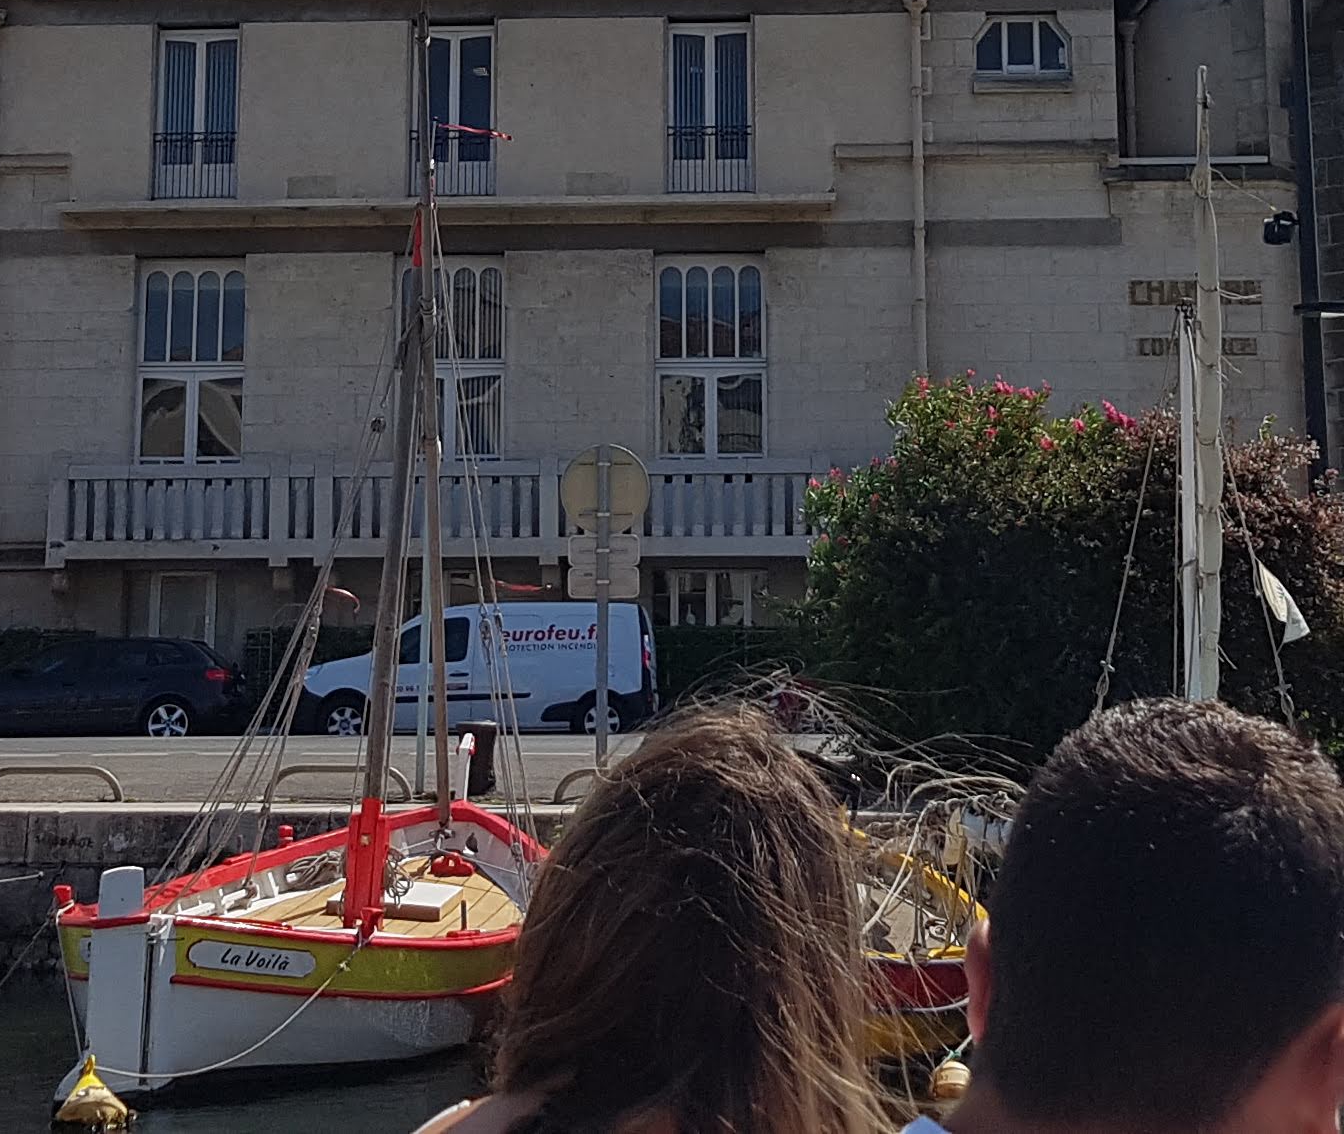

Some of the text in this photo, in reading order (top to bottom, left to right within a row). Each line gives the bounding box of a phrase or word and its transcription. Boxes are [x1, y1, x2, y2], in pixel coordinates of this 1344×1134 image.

[502, 623, 598, 642] eurofeu.f
[220, 947, 290, 971] La Voilà
